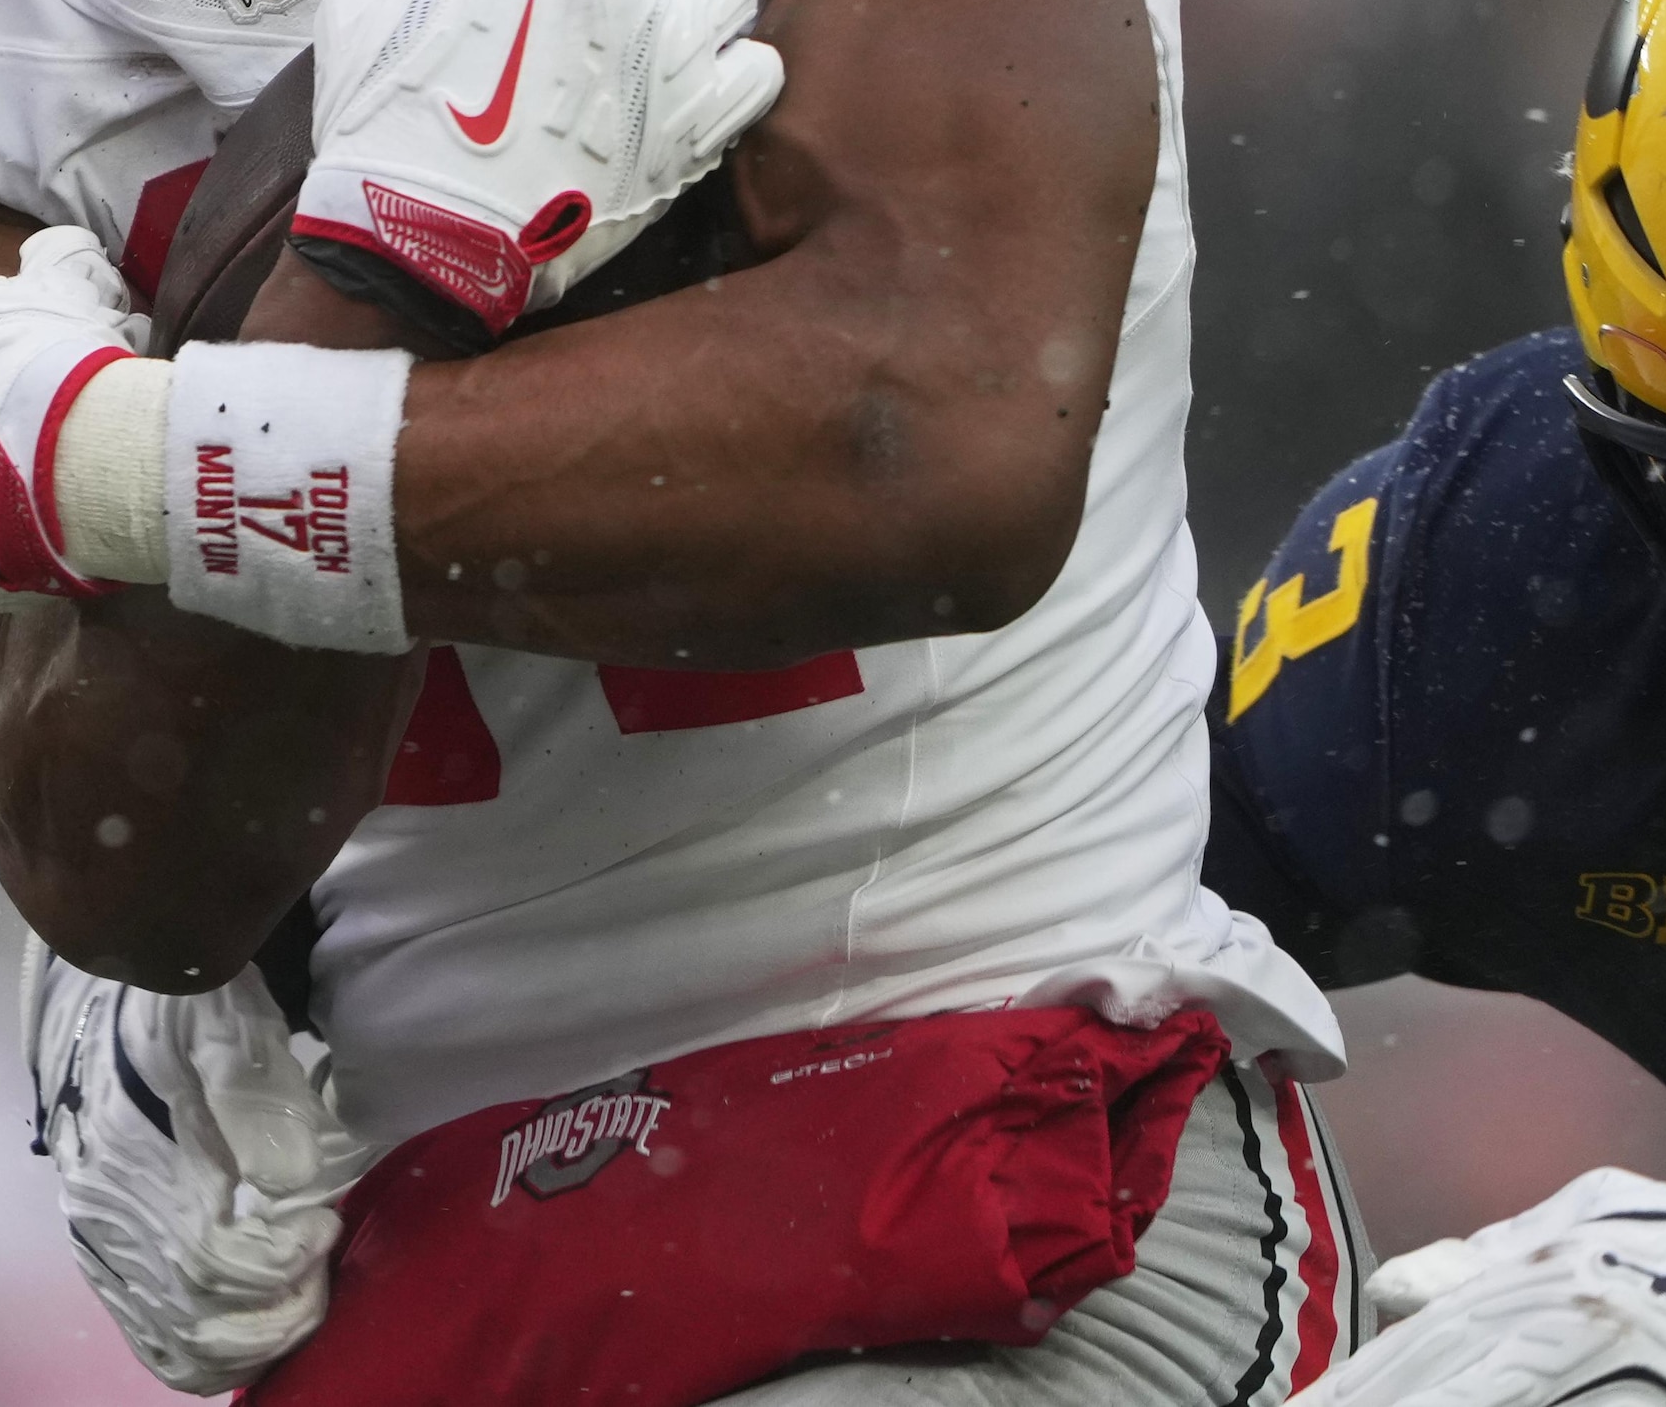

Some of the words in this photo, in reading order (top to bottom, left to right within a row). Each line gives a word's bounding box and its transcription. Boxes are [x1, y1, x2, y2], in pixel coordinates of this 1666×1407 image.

[195, 444, 240, 576] MUNYUN
[237, 488, 311, 553] 17
[308, 464, 352, 574] TOUCH
[1226, 496, 1379, 726] 3
